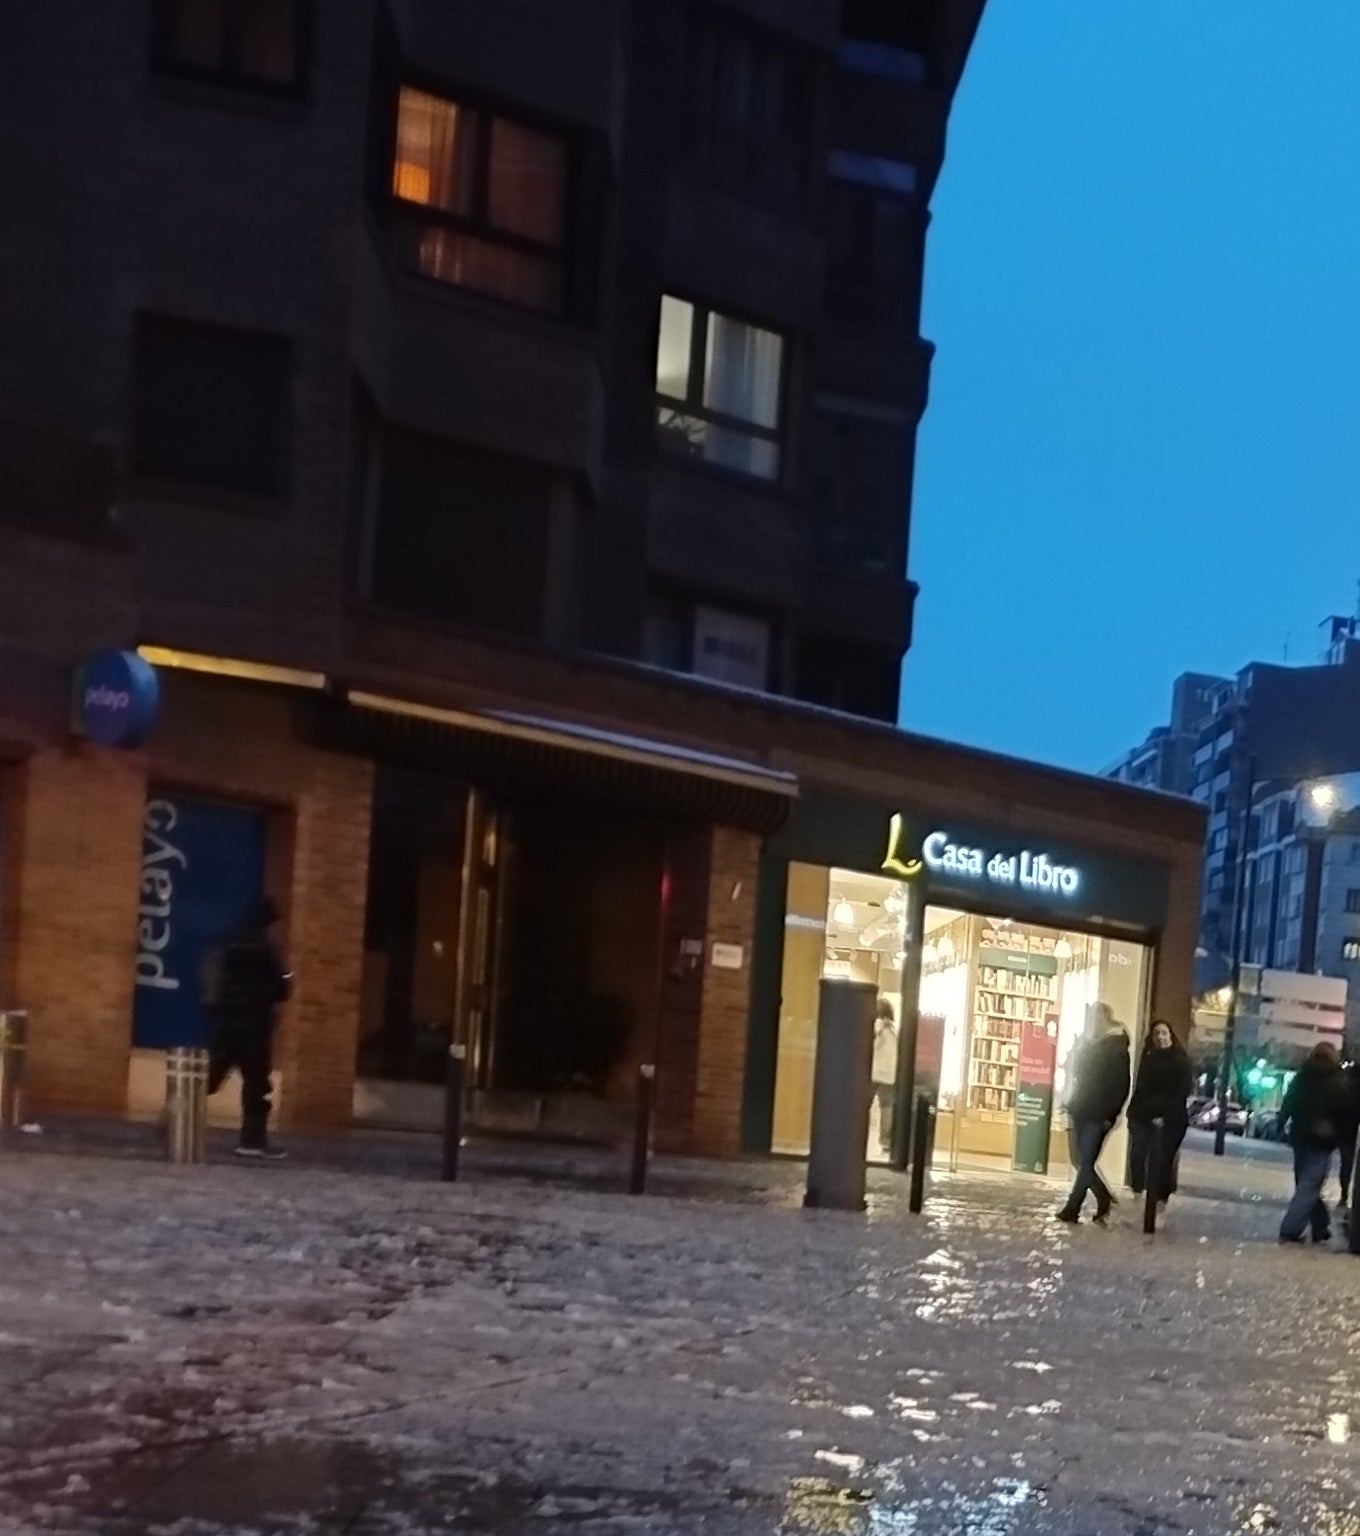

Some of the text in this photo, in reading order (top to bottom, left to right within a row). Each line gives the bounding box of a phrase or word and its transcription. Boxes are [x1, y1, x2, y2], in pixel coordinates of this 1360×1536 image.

[922, 832, 984, 873] Casa
[988, 853, 1017, 880] del
[1019, 850, 1080, 892] Libro
